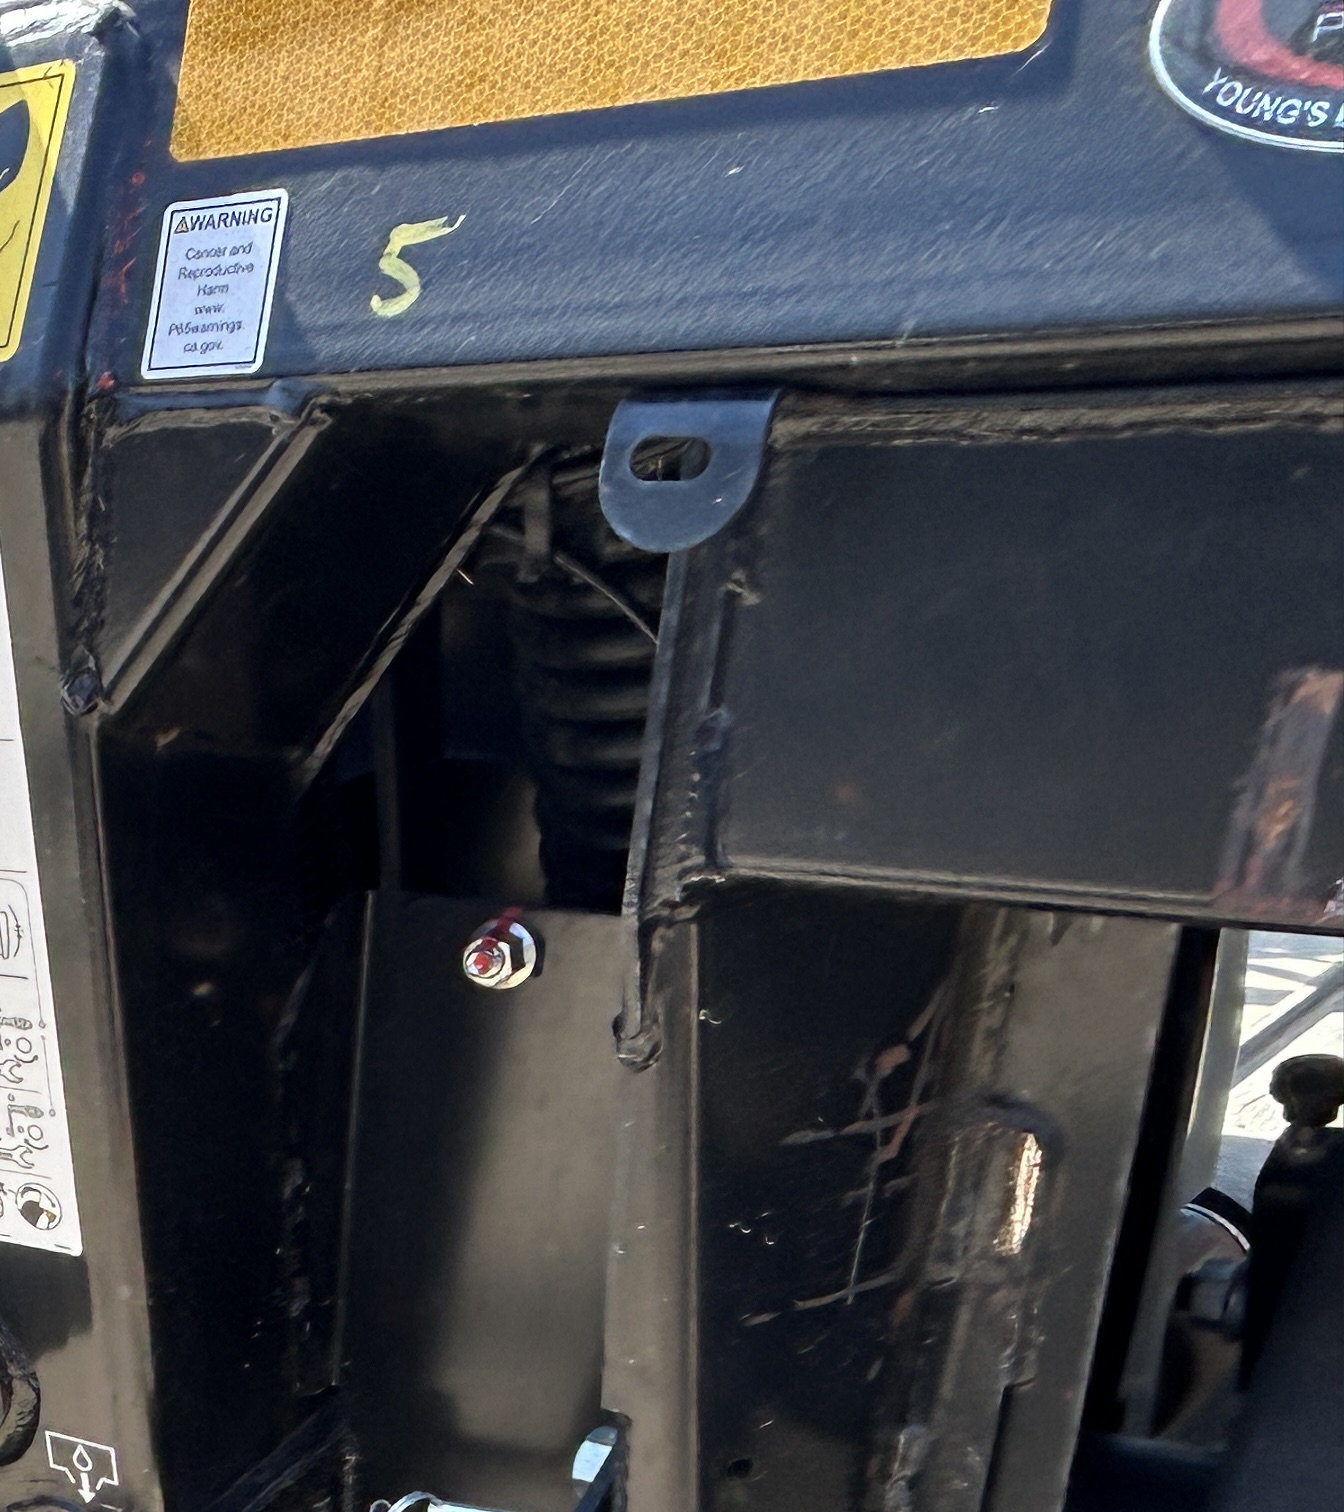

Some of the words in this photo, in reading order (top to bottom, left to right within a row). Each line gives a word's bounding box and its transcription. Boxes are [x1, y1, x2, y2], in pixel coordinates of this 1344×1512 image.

[1202, 66, 1330, 127] YOUNG'S
[190, 207, 273, 231] WARNING
[186, 246, 227, 261] Cancer
[229, 241, 254, 257] and
[178, 262, 254, 280] Reproductive
[371, 213, 466, 317] 5
